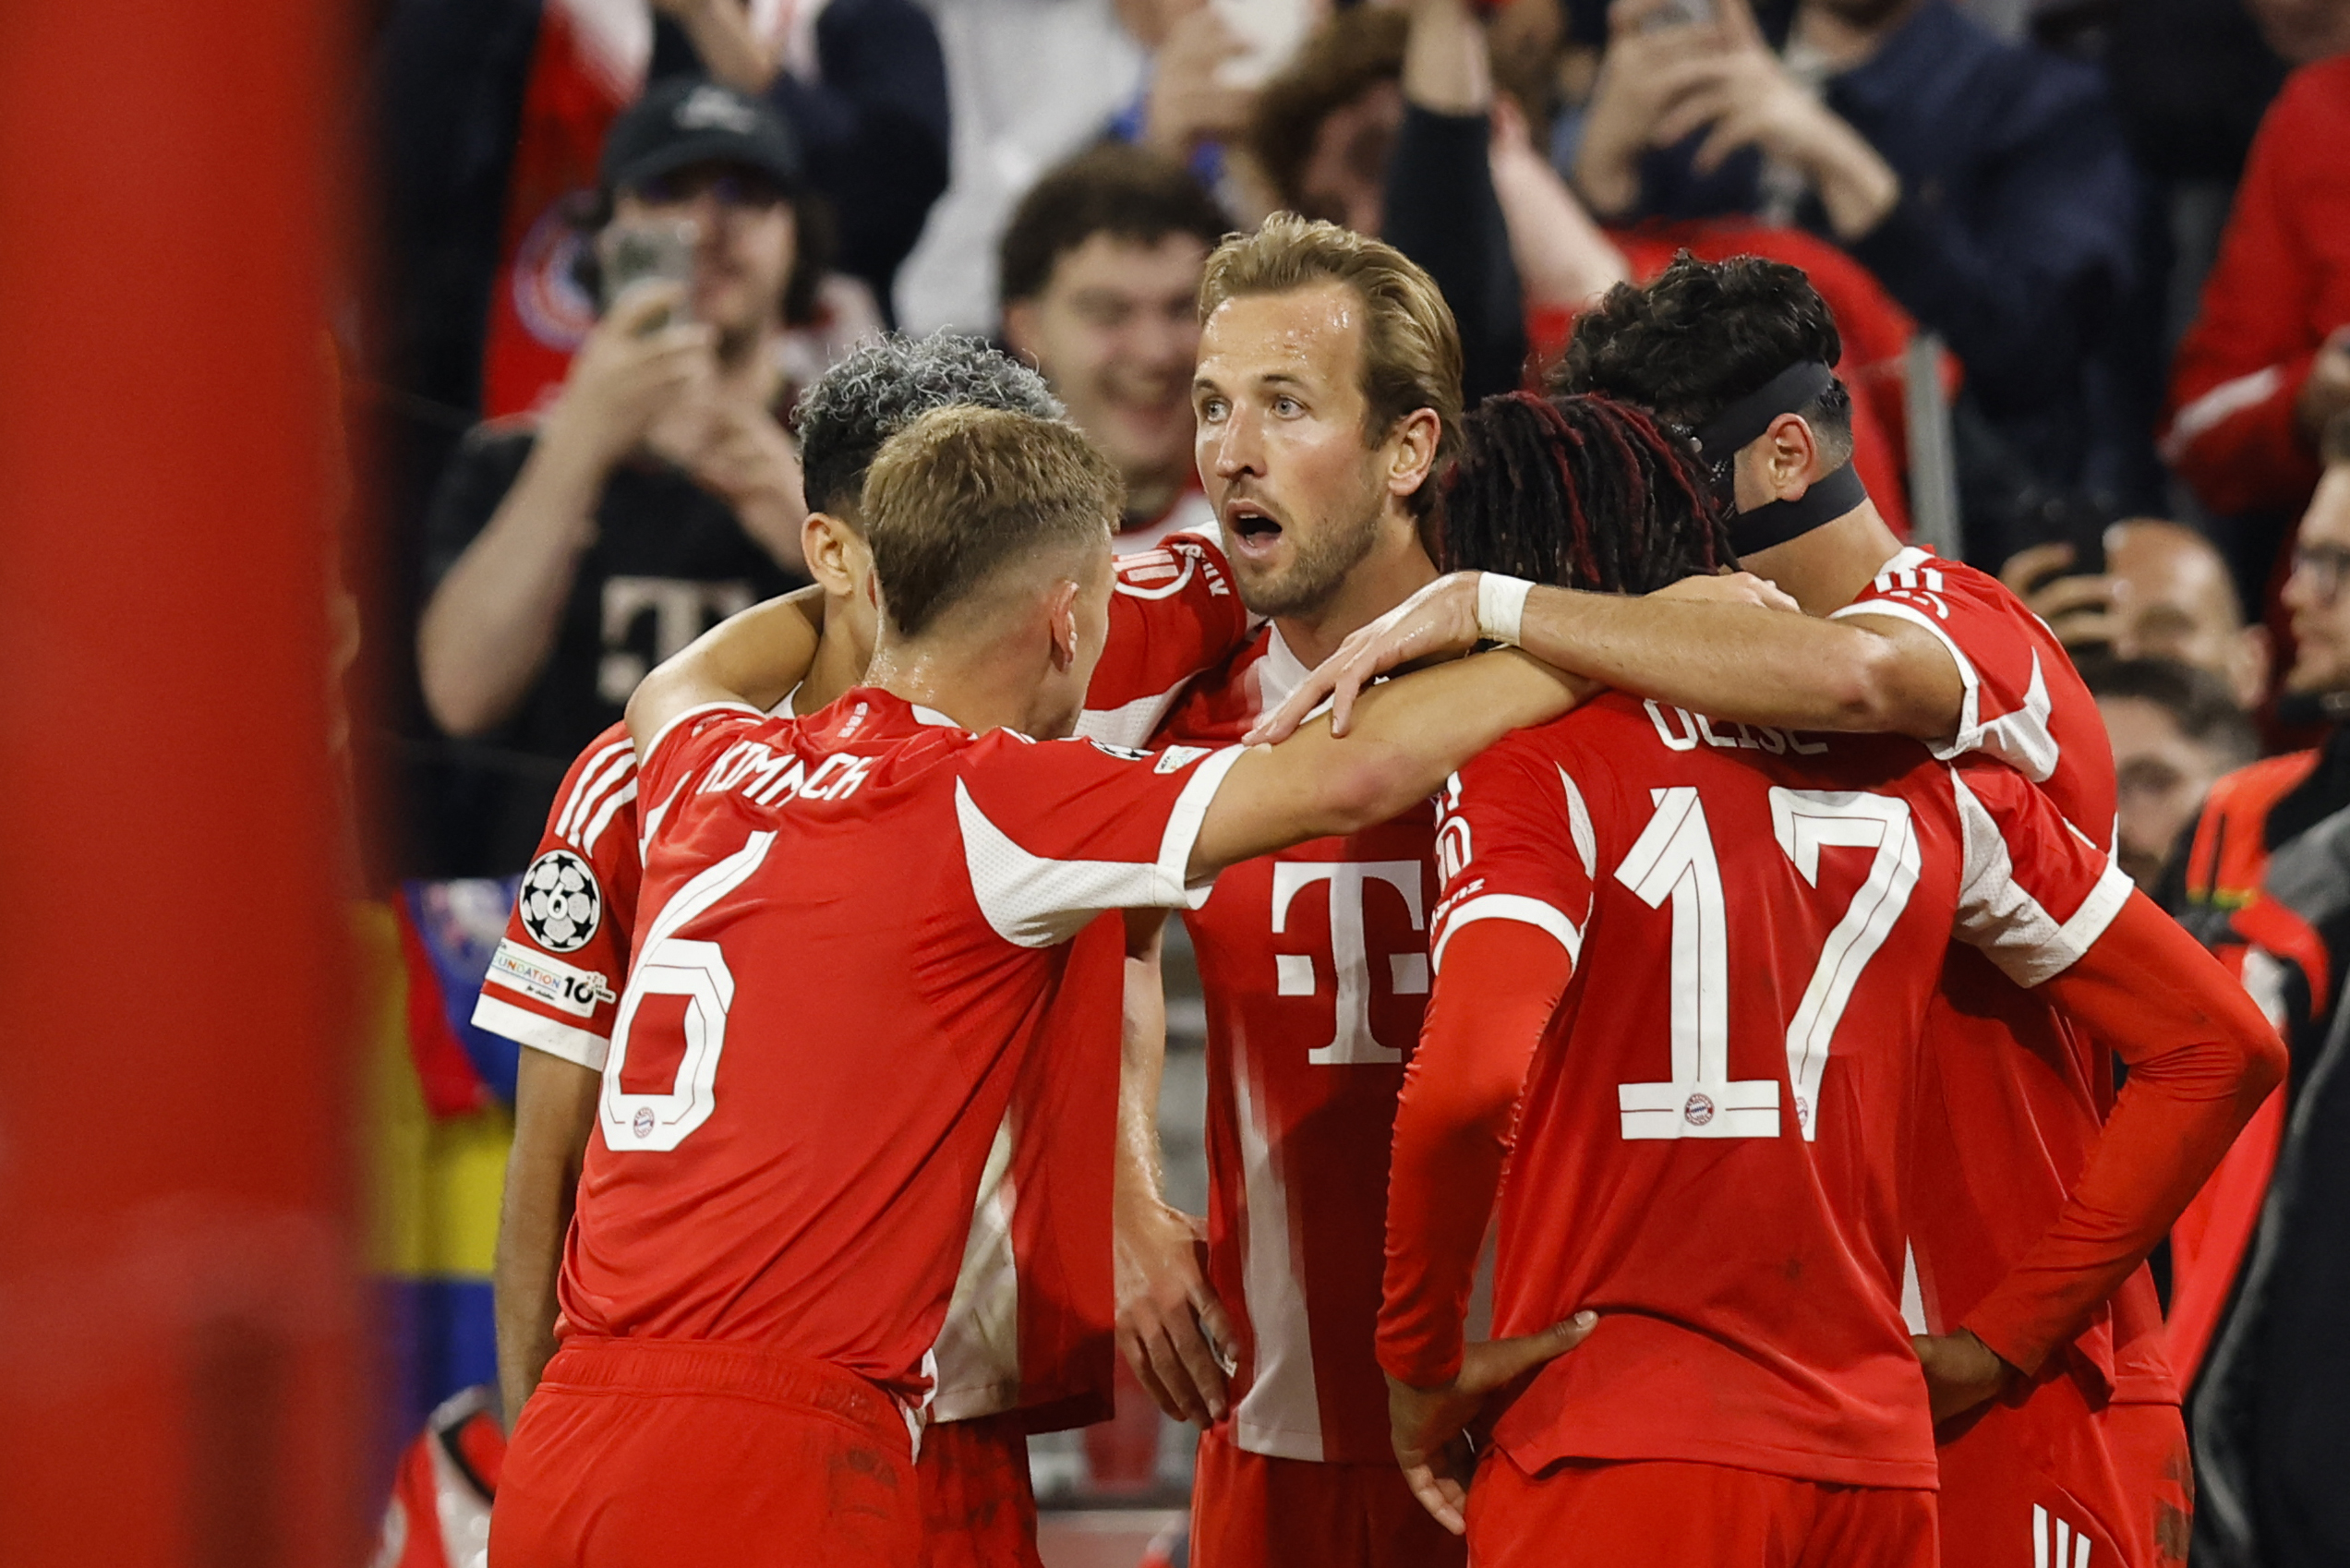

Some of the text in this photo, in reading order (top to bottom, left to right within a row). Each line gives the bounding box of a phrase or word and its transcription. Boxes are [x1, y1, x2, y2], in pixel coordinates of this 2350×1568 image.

[547, 882, 569, 921] 6
[563, 975, 595, 1004] 10
[600, 830, 778, 1152] 6
[1271, 860, 1428, 1065] T
[1613, 786, 1922, 1142] 17
